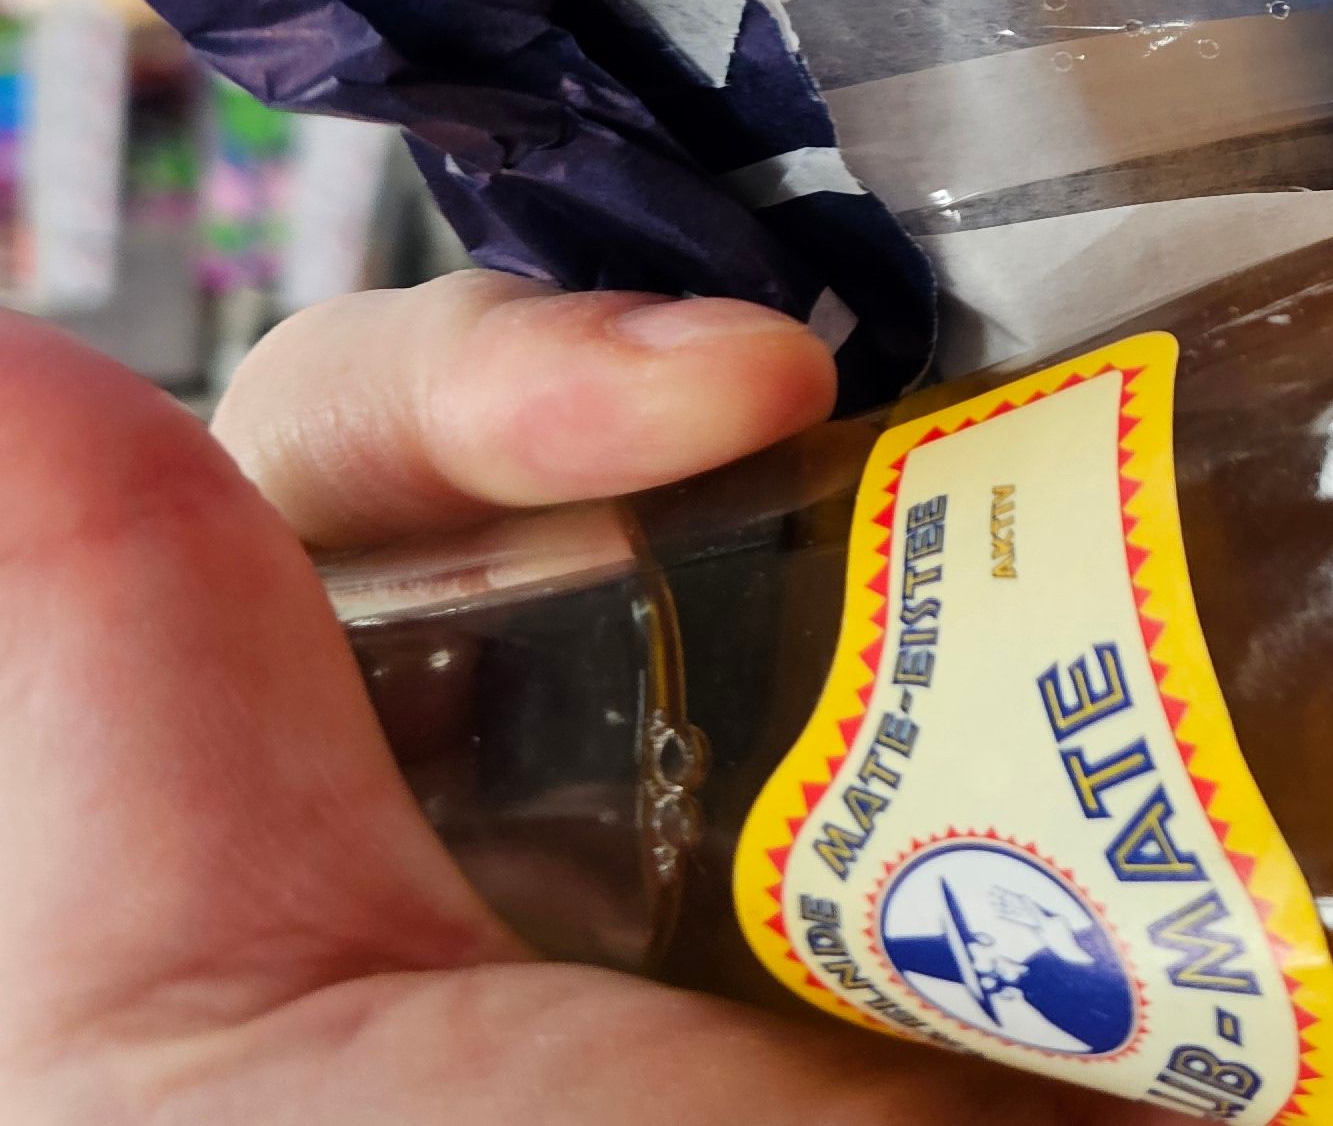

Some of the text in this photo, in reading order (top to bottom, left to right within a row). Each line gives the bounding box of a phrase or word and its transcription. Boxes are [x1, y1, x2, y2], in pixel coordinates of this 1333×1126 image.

[811, 493, 949, 881] MATE-EISTEE
[988, 483, 1019, 579] AKTIV
[1035, 640, 1262, 1119] UB-MATE
